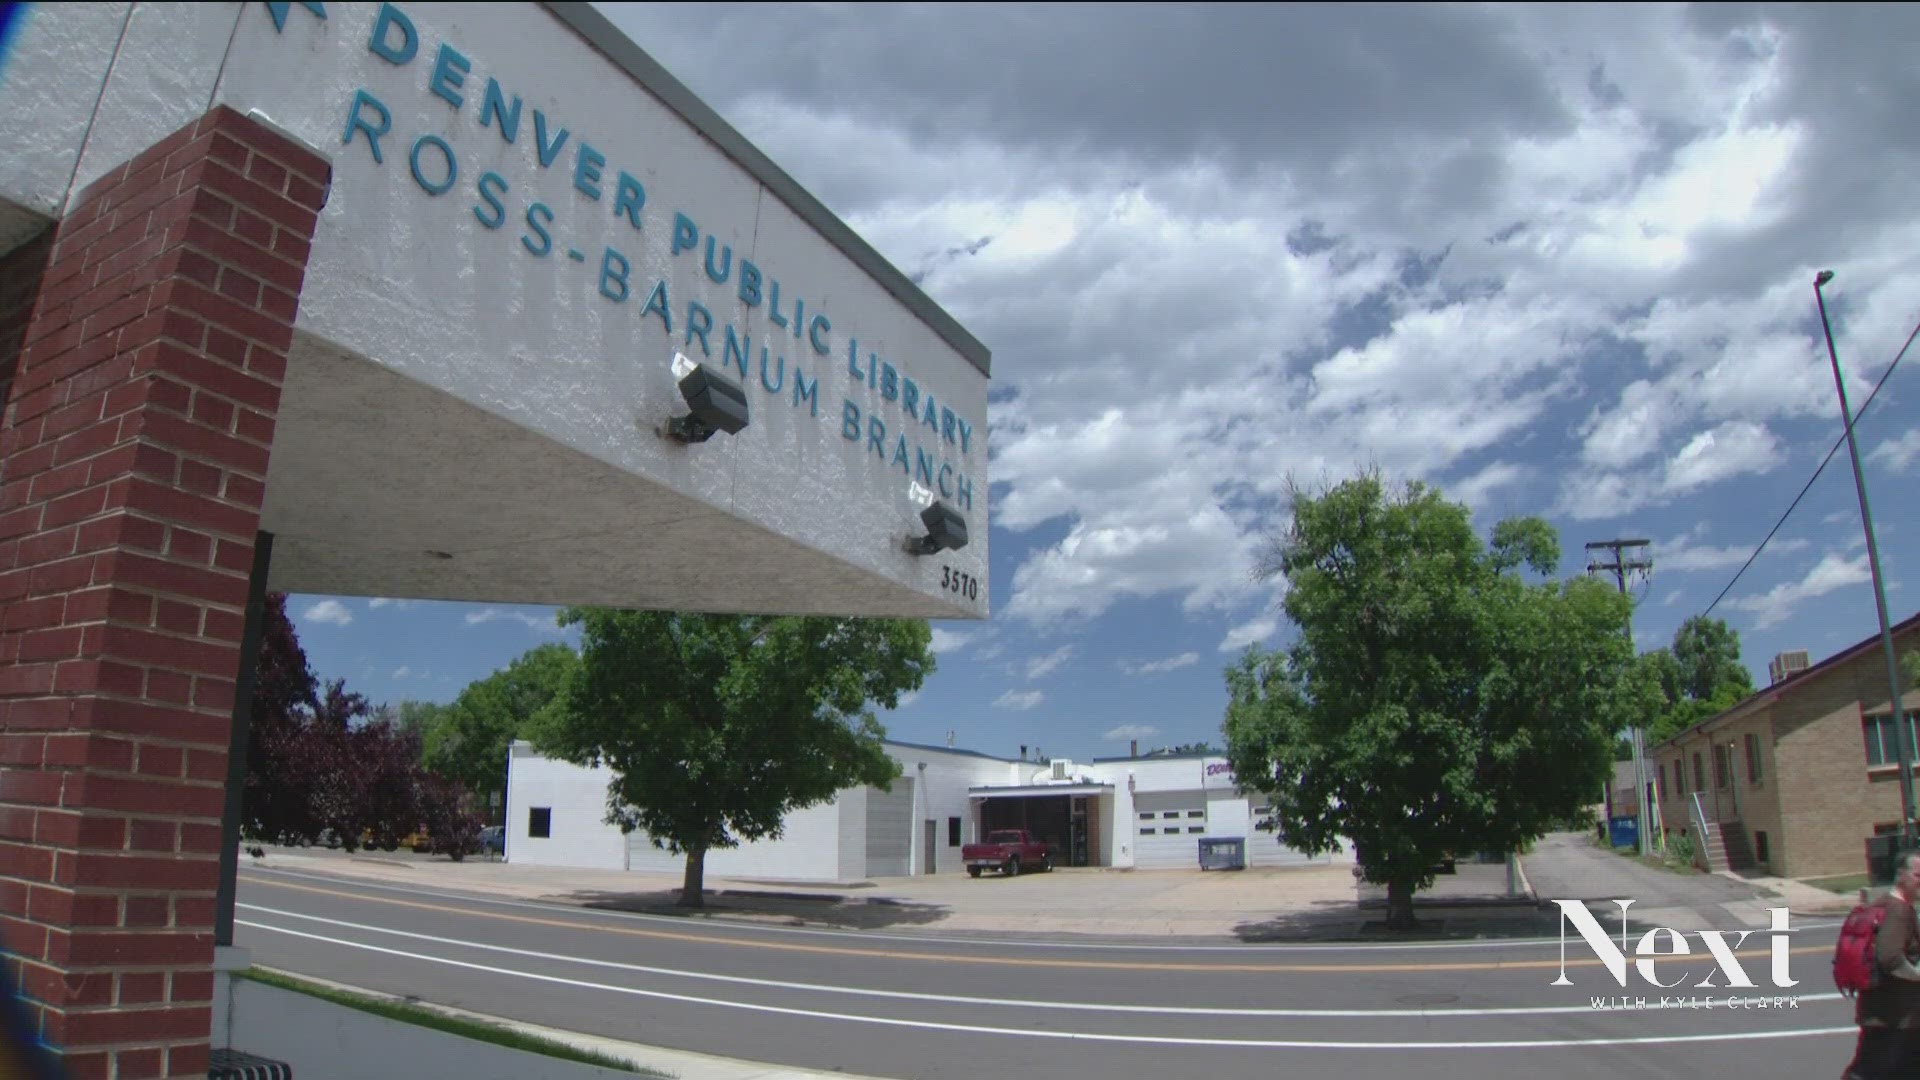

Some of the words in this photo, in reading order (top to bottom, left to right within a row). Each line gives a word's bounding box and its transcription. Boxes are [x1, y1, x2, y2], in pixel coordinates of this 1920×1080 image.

[342, 88, 818, 417] ROSS-BARNUM
[842, 398, 973, 511] BRANCH
[369, 2, 646, 229] DENVER
[671, 212, 831, 355] PUBLIC
[848, 338, 973, 455] LIBRARY
[941, 565, 977, 600] 3570
